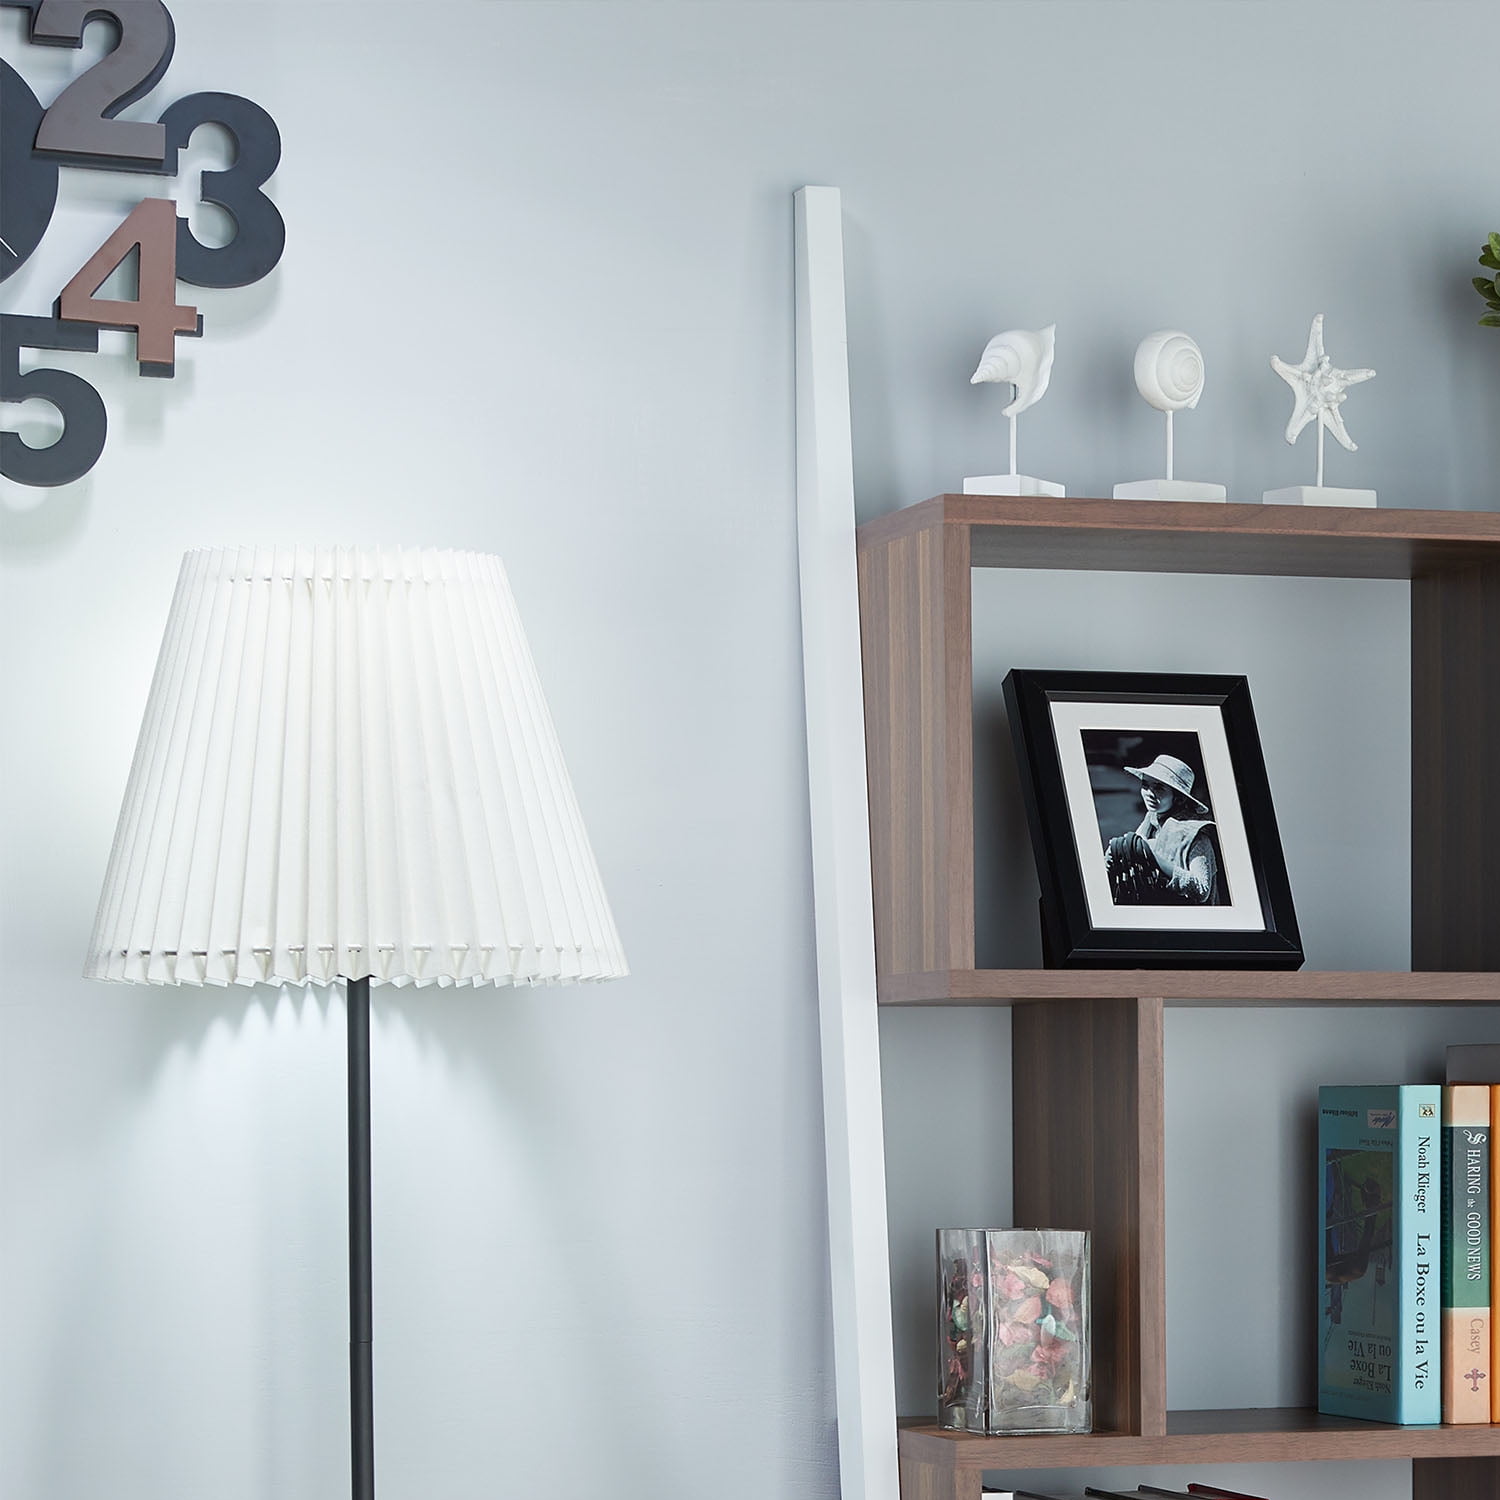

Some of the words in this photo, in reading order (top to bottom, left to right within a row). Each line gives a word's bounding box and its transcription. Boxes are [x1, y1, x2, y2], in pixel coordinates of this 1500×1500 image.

[32, 0, 176, 176] 2
[157, 92, 285, 288] 3
[53, 198, 203, 378] 4
[0, 314, 107, 487] 5
[1418, 1136, 1430, 1169] Noah
[1414, 1173, 1430, 1213] Klieger
[1417, 1233, 1431, 1256] La
[1467, 1212, 1481, 1245] GOOD
[1467, 1248, 1481, 1280] NEWS
[1416, 1262, 1430, 1306] Boxe
[1416, 1312, 1426, 1334] ou
[1467, 1318, 1484, 1354] Casey
[1415, 1340, 1428, 1354] la
[1350, 1360, 1375, 1378] Boxe
[1415, 1360, 1429, 1389] Vie
